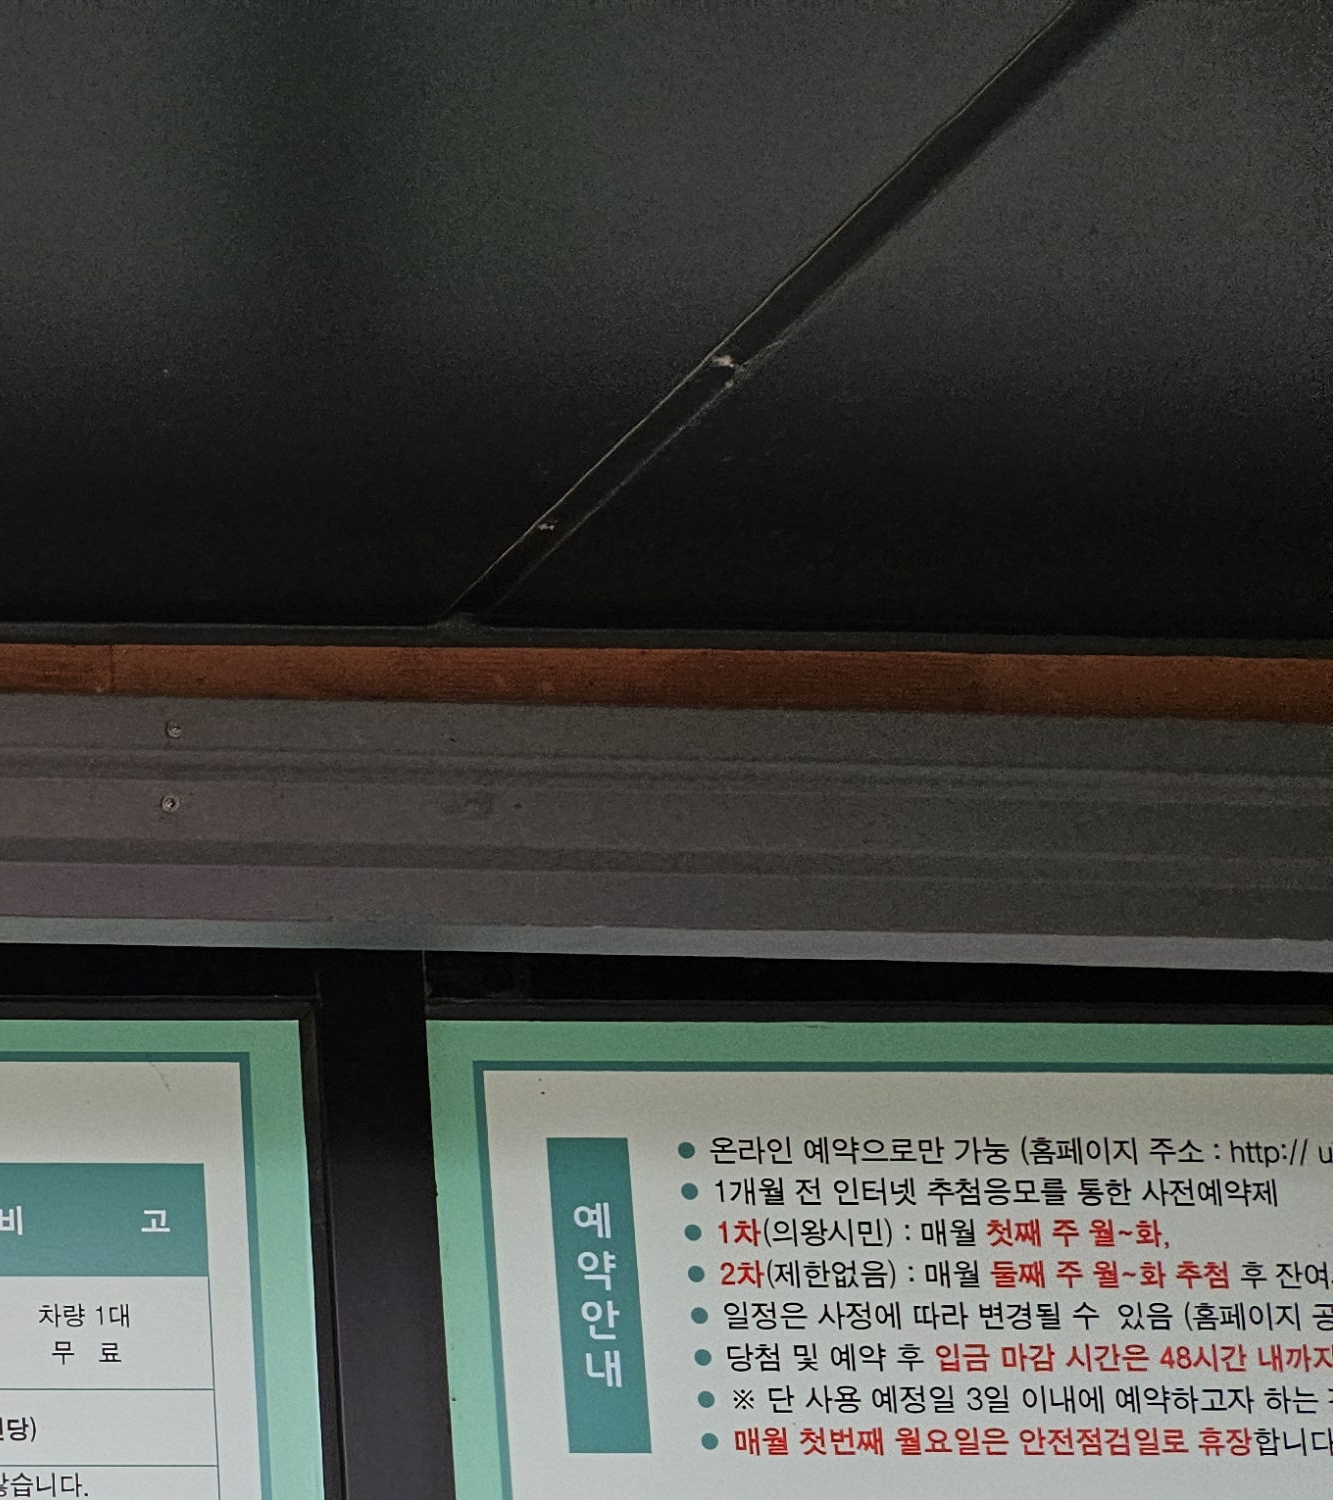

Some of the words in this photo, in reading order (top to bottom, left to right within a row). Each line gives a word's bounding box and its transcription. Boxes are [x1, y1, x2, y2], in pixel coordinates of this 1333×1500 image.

[710, 1136, 792, 1164] 온라인
[804, 1137, 944, 1164] 예약으로만
[715, 1177, 784, 1205] 1개월
[834, 1178, 916, 1205] 인터넷
[928, 1178, 1067, 1206] 추첨응모를
[1142, 1178, 1277, 1207] 사전예약제
[719, 1218, 892, 1247] 1차(의왕시민)
[721, 1259, 895, 1289] 2차(제한없음)
[39, 1304, 85, 1327] 차량
[96, 1304, 129, 1327] 1대
[936, 1344, 990, 1372] 입금
[1160, 1344, 1247, 1372] 48시간
[895, 1427, 1009, 1455] 월요일은
[1020, 1427, 1189, 1456] 안전점검일로
